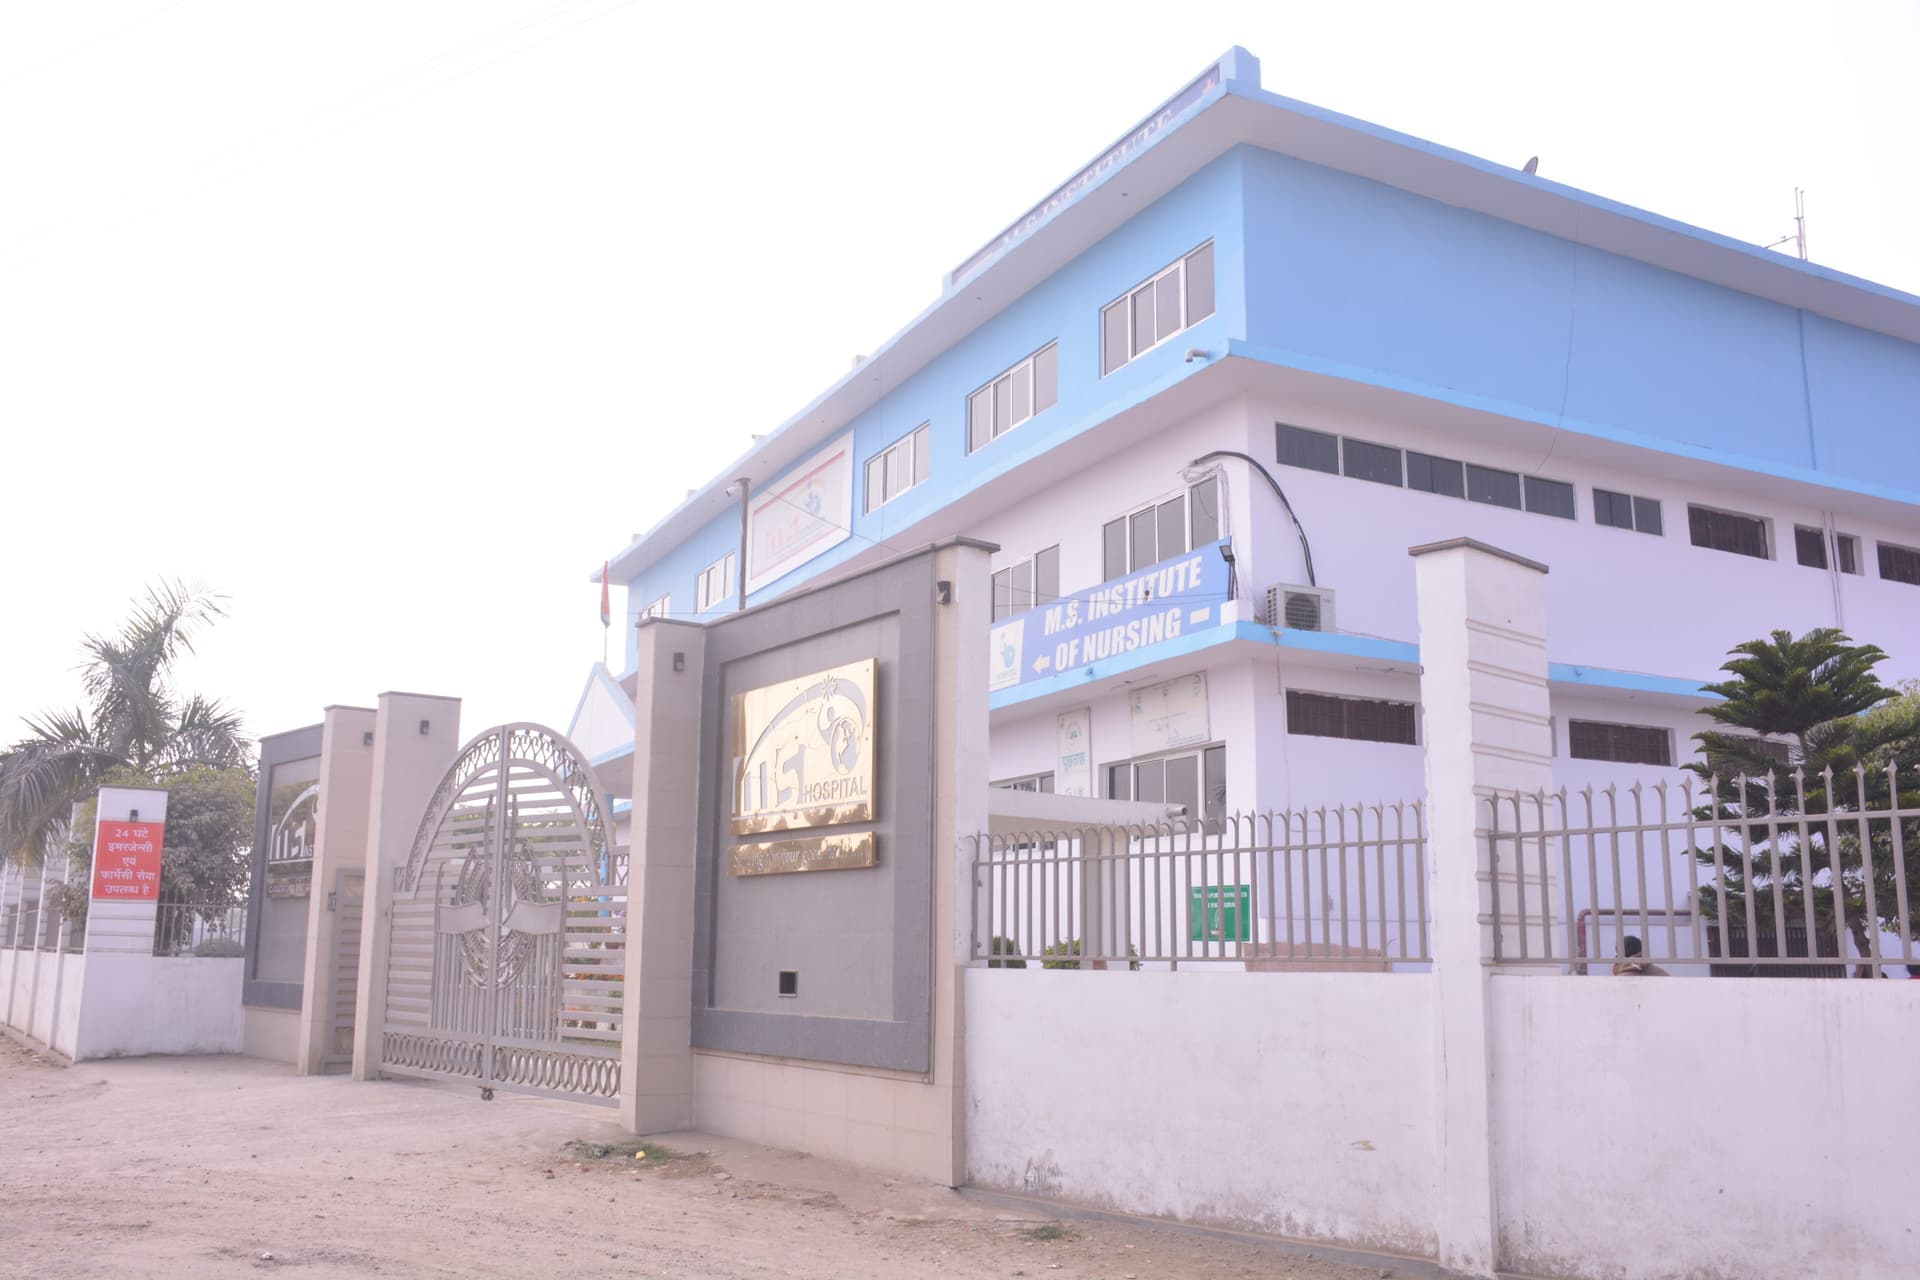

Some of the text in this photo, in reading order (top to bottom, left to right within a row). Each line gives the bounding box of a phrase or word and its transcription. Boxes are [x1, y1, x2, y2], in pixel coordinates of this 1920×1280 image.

[1044, 556, 1203, 636] M.S. INSTITUTE
[1055, 607, 1182, 672] OF NURSING
[804, 775, 867, 802] HOSPITAL
[114, 828, 129, 838] 24
[136, 869, 155, 880] सेवा
[104, 883, 150, 895] उपलब्ध है
